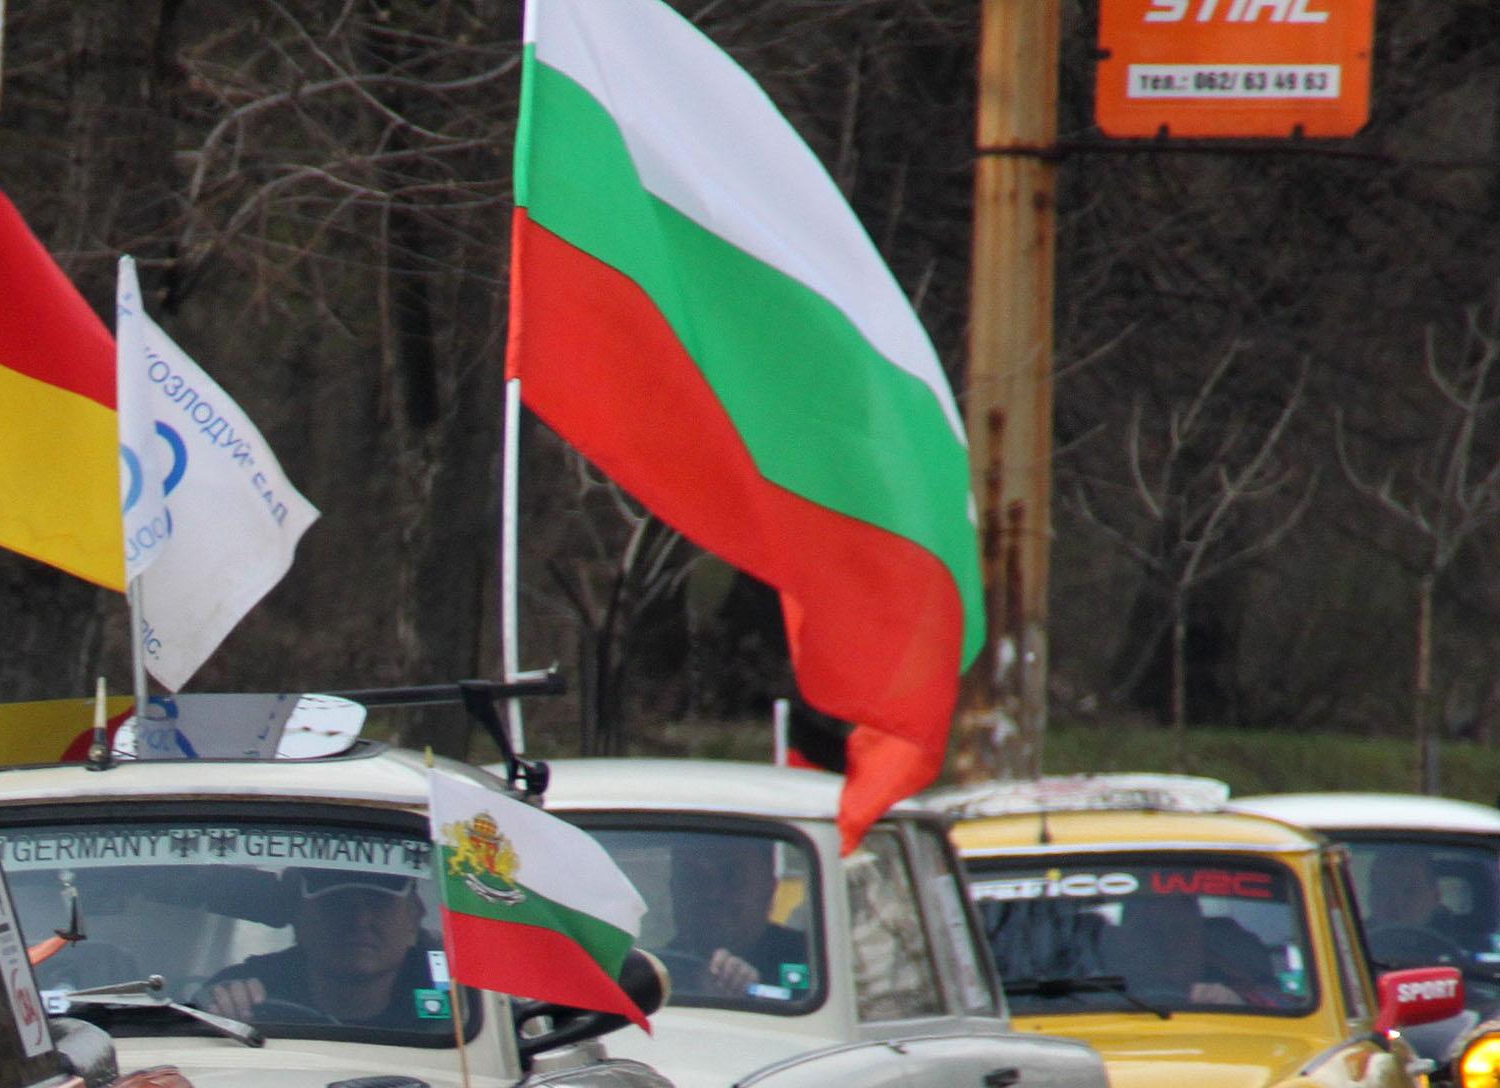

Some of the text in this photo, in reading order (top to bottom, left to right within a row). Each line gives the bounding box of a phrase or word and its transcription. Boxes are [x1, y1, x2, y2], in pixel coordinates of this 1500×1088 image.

[12, 831, 162, 862] GERMANY
[245, 829, 398, 866] GERMANY
[1397, 978, 1459, 1002] SPORT
